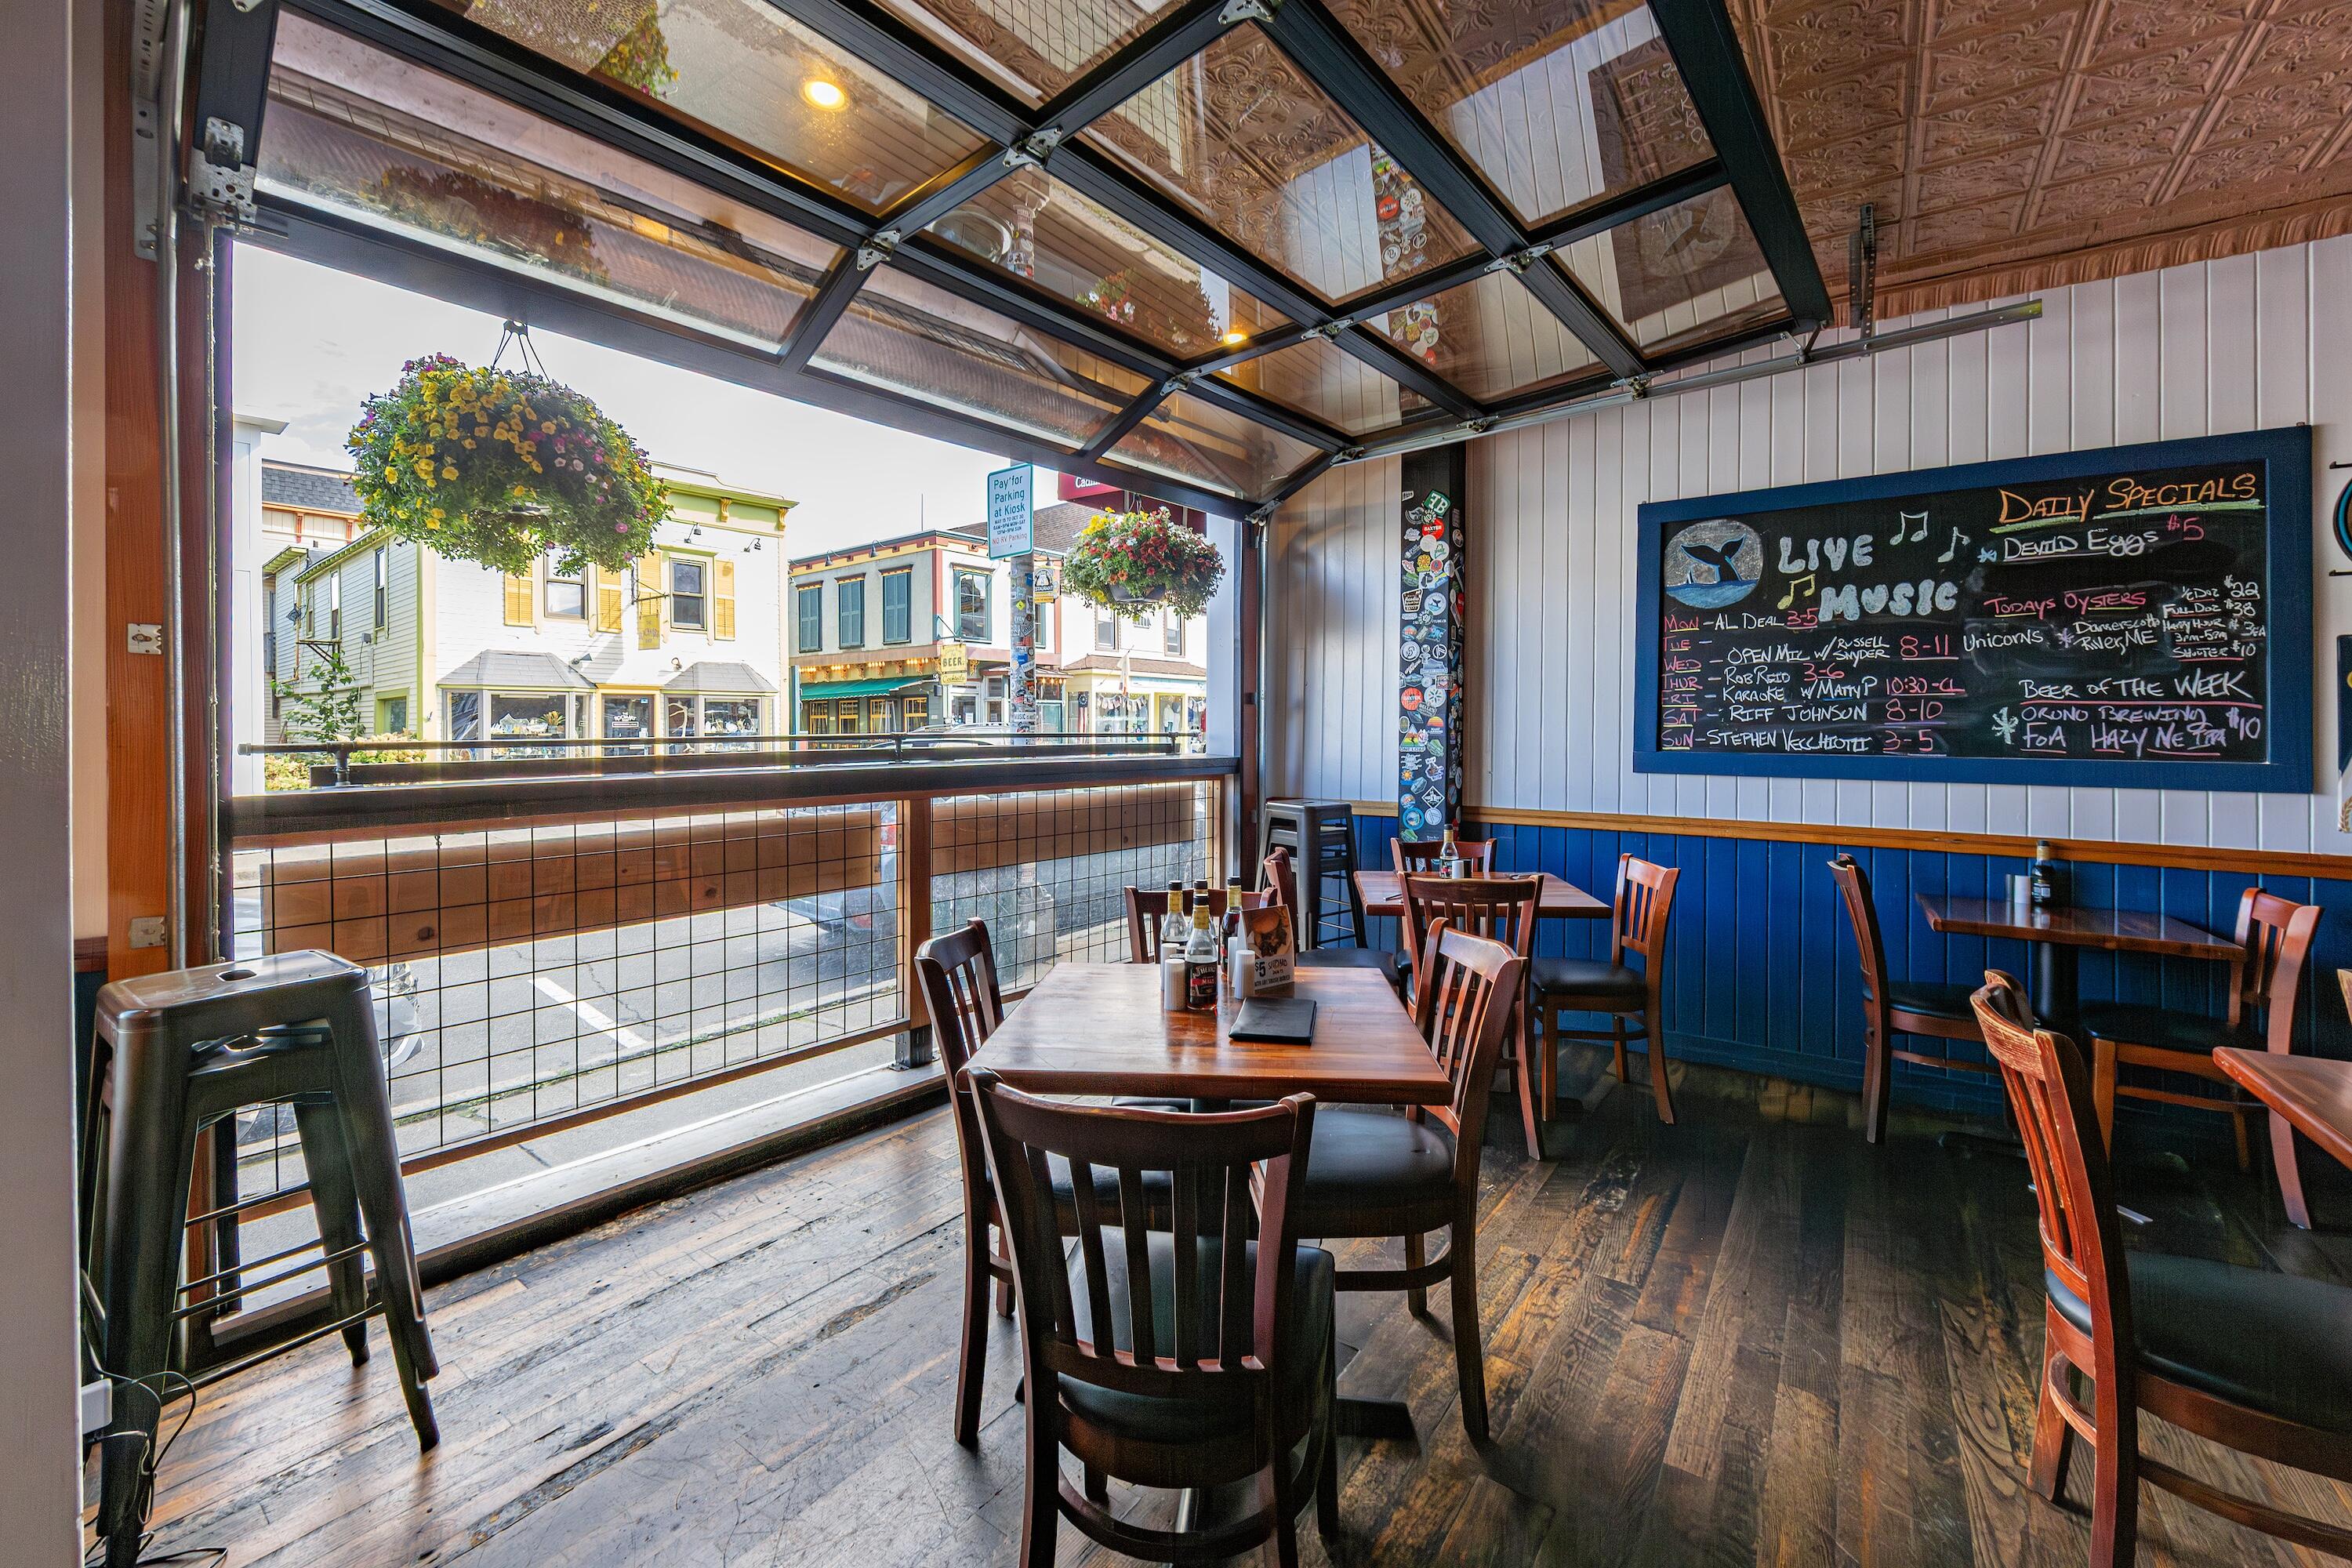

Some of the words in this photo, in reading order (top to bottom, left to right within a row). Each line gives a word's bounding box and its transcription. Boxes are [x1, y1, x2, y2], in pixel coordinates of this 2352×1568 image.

[993, 479, 1008, 490] Pay
[1011, 475, 1023, 485] for
[995, 489, 1025, 504] Parking
[1999, 488, 2094, 524] DAILY
[2106, 473, 2256, 509] SPECIALS
[994, 506, 1002, 517] at
[1004, 502, 1025, 515] Kiosk
[2166, 514, 2205, 541] $5
[1000, 535, 1008, 543] RV
[1008, 532, 1028, 543] Parking
[1778, 534, 1873, 574] LIVE
[1818, 579, 1958, 622] MUSIC
[2064, 592, 2146, 615] OYSTERS
[2223, 598, 2256, 616] $38
[1742, 613, 1784, 630] DEAL
[1664, 656, 1702, 671] WED
[1727, 645, 1772, 664] OPEN
[1837, 636, 1890, 649] RUSSELL
[1833, 649, 1890, 667] SNYDER
[2230, 640, 2256, 657] $10
[1661, 673, 1703, 690] THUR
[2019, 680, 2080, 699] BEER
[2113, 678, 2164, 697] THE
[2174, 668, 2254, 699] WEEK
[1661, 690, 1696, 705] FRI
[1722, 685, 1785, 703] KARAOKE
[1663, 707, 1703, 724] SAT
[1730, 705, 1775, 722] RIFF
[1781, 702, 1867, 721] JOHNSON
[2021, 706, 2089, 721] ORONO
[2099, 706, 2206, 727] BREWING
[2226, 706, 2261, 741] $10
[1661, 728, 1694, 747] SUN
[1706, 729, 1777, 747] STEPHEN
[2091, 722, 2148, 758] HAZY
[1255, 961, 1266, 978] $5
